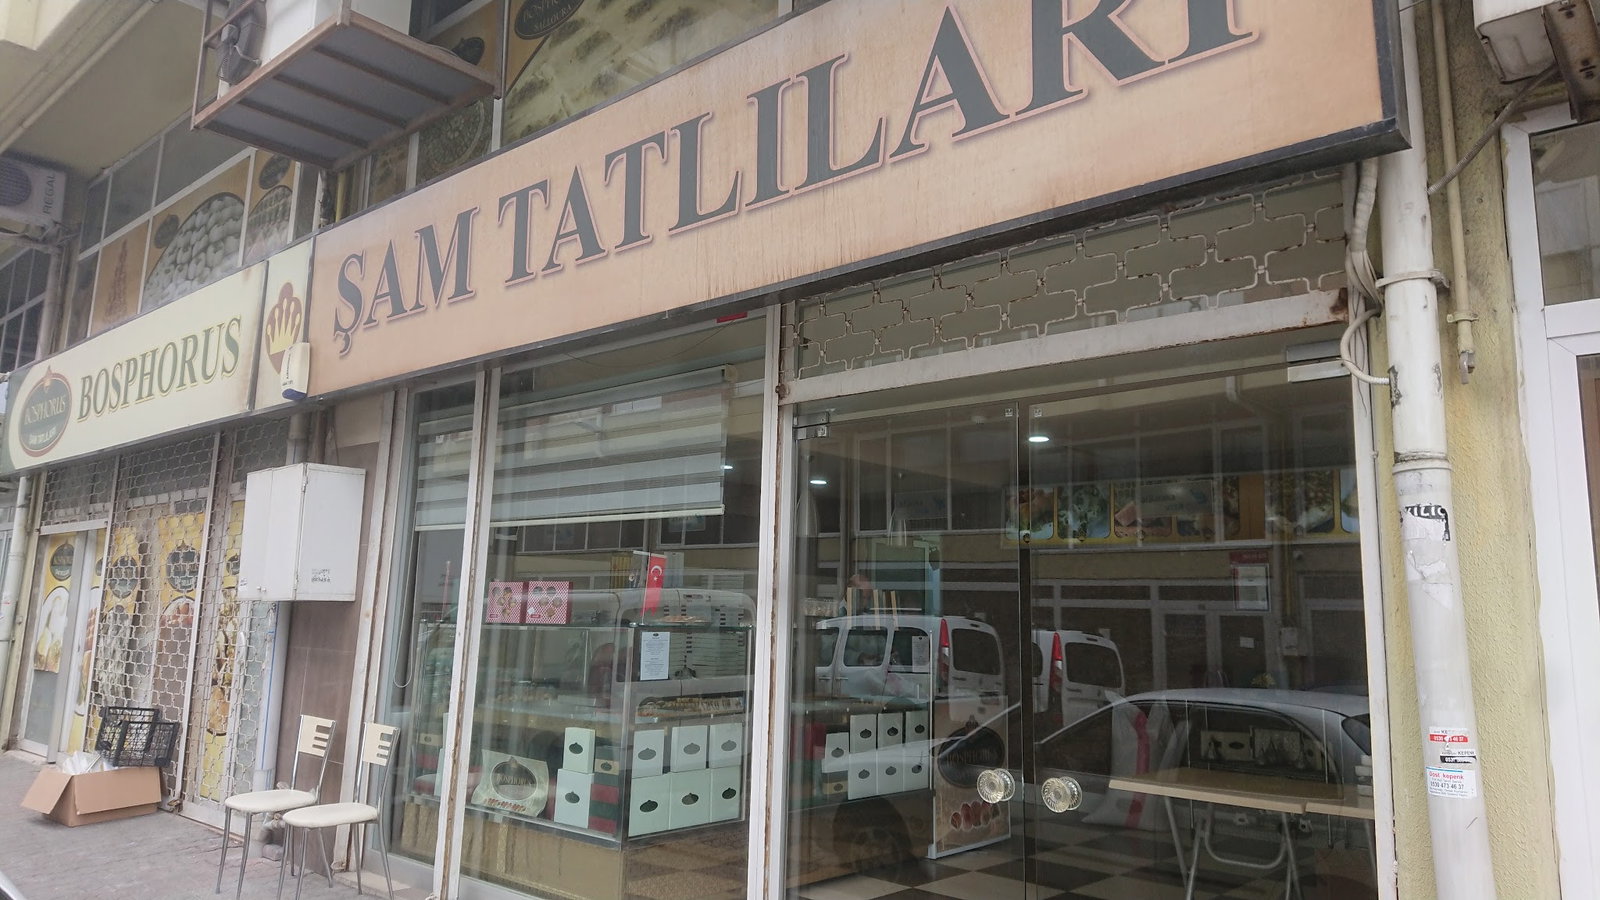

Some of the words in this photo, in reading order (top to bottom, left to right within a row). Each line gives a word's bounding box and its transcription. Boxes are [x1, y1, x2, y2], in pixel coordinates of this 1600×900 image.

[42, 172, 57, 215] REGAL
[333, 206, 480, 356] ŞAM
[77, 316, 243, 423] BOSPHORUS
